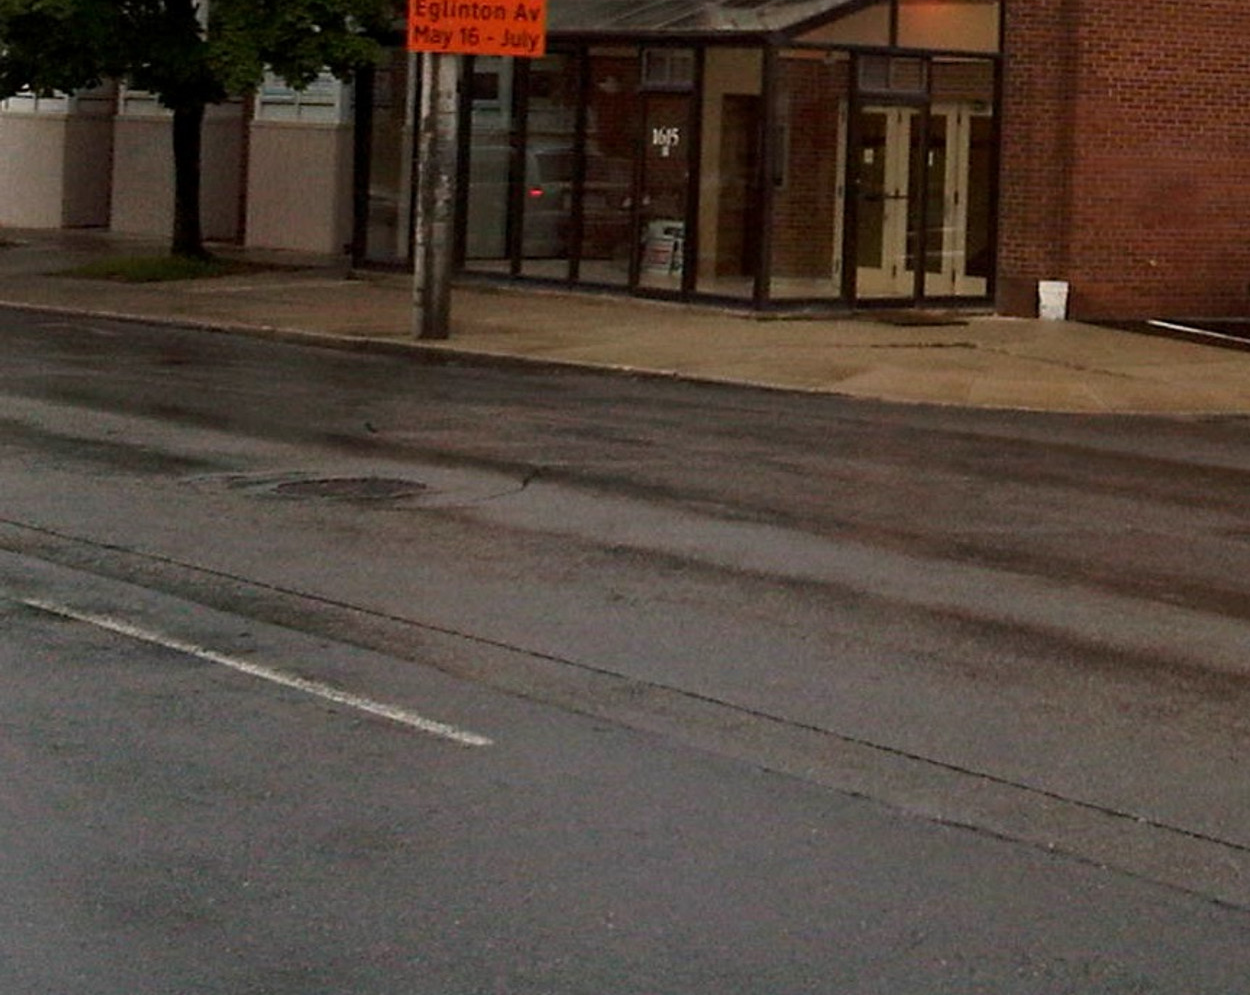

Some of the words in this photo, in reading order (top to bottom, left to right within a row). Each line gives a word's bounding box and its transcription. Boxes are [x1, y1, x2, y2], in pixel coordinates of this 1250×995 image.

[513, 3, 541, 22] Av
[414, 25, 452, 49] May
[460, 27, 480, 46] 16
[501, 29, 540, 52] July
[652, 126, 680, 146] 1615
